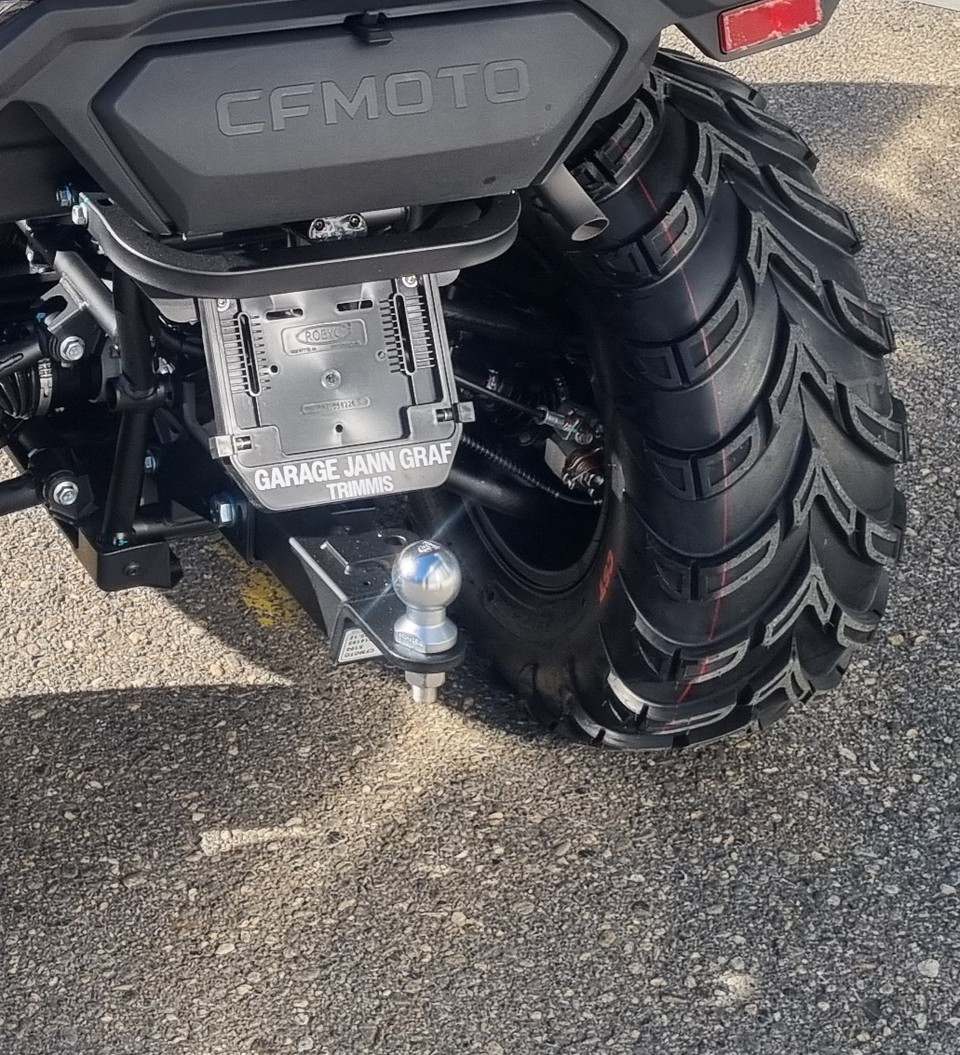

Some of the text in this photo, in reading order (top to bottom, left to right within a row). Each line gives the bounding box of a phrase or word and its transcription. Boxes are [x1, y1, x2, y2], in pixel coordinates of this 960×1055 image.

[215, 58, 530, 137] CFMOTO
[254, 442, 453, 491] GARAGE JANN GRAF
[326, 475, 394, 500] TRIMMIS
